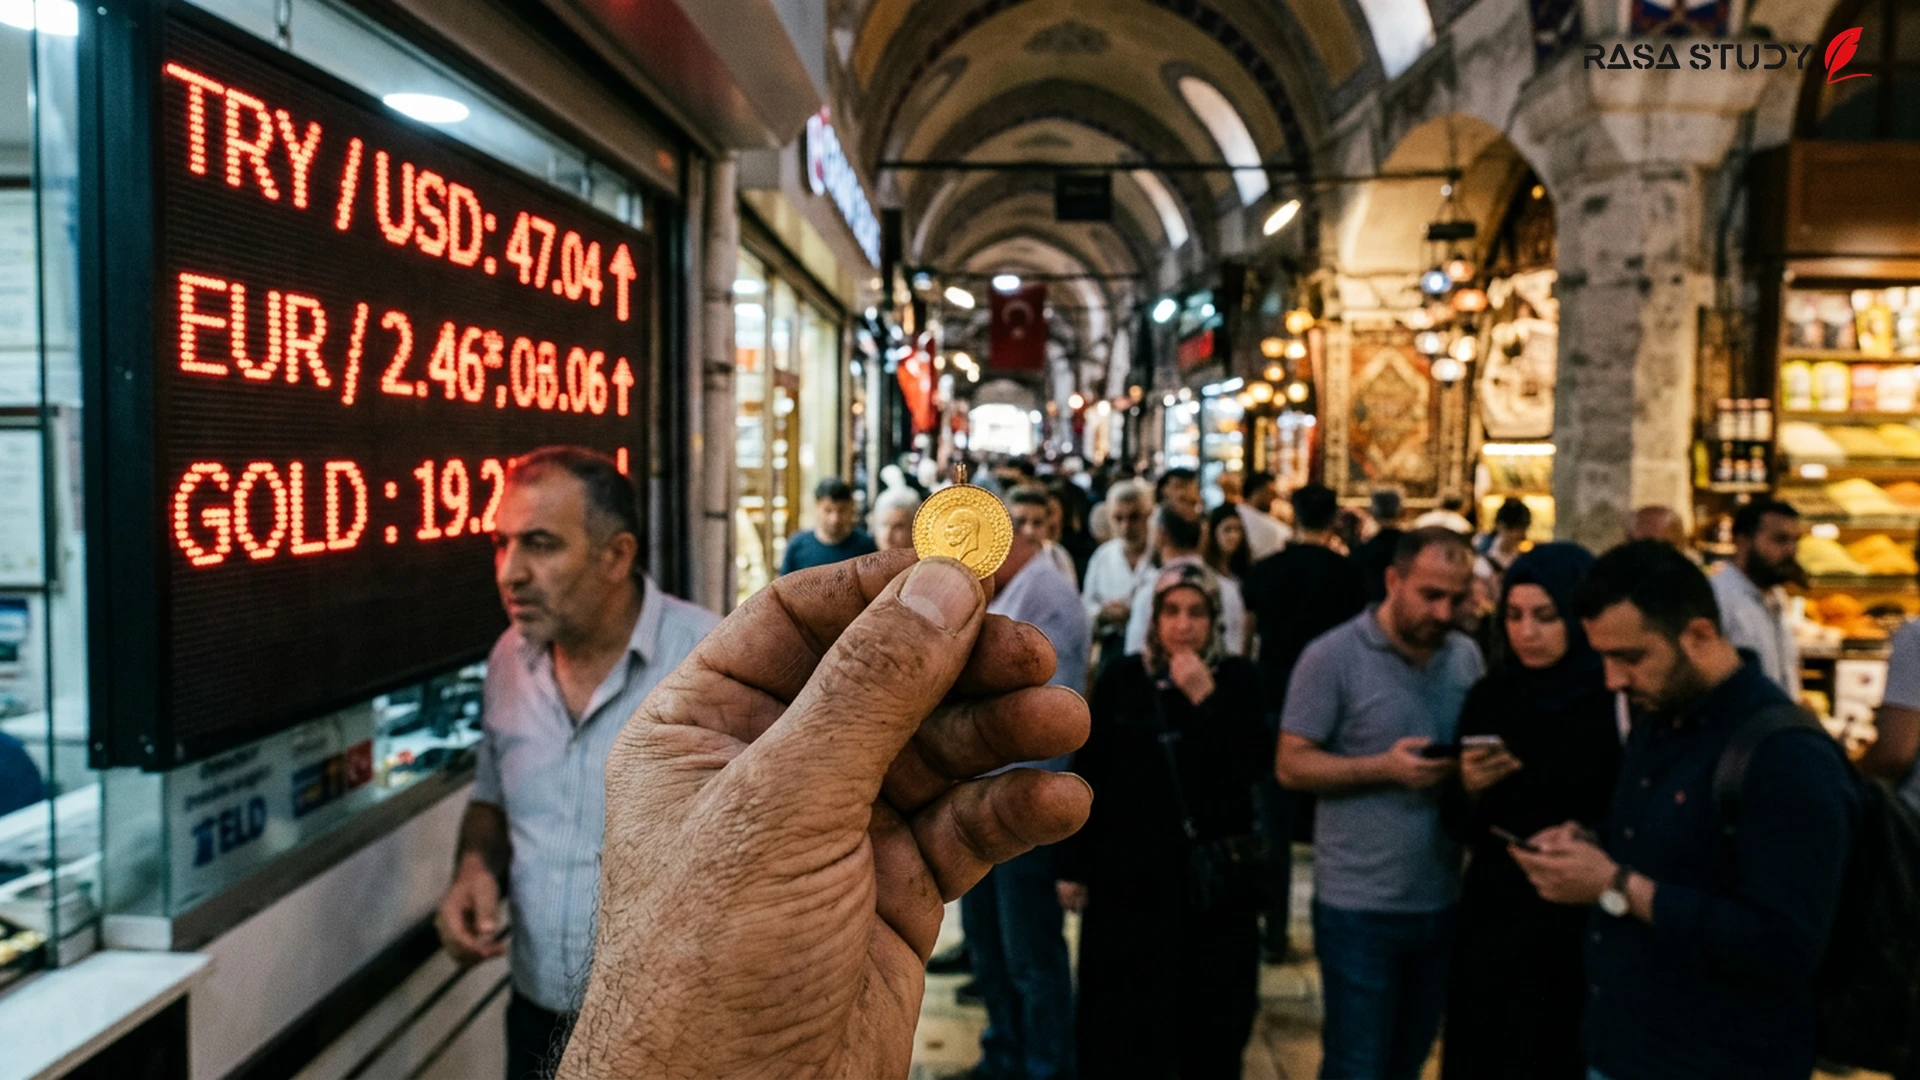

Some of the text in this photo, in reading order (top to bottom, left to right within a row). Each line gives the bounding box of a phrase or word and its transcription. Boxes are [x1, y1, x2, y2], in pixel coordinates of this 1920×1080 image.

[505, 211, 603, 306] 47.04
[178, 272, 332, 388] EUR
[414, 458, 517, 540] 19.2
